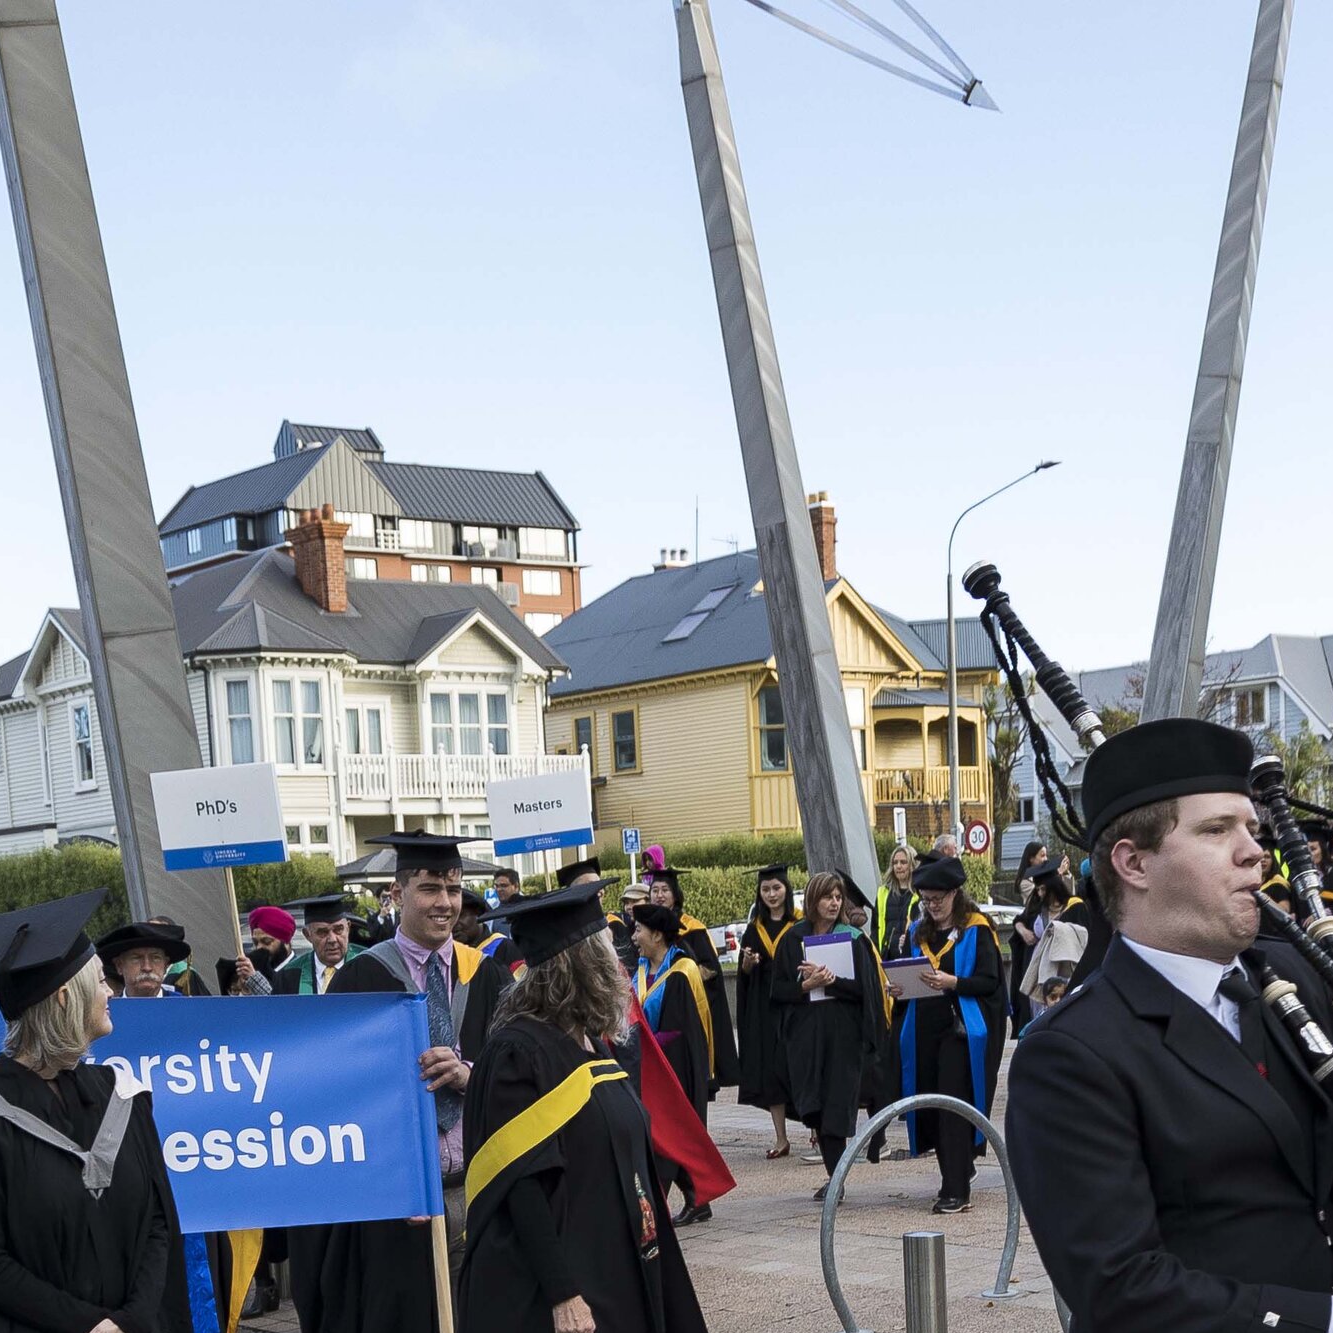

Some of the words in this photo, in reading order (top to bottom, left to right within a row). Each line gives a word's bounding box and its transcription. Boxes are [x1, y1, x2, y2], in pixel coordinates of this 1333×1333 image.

[513, 799, 563, 814] Masters
[971, 831, 985, 843] 30
[162, 1111, 366, 1173] ession
